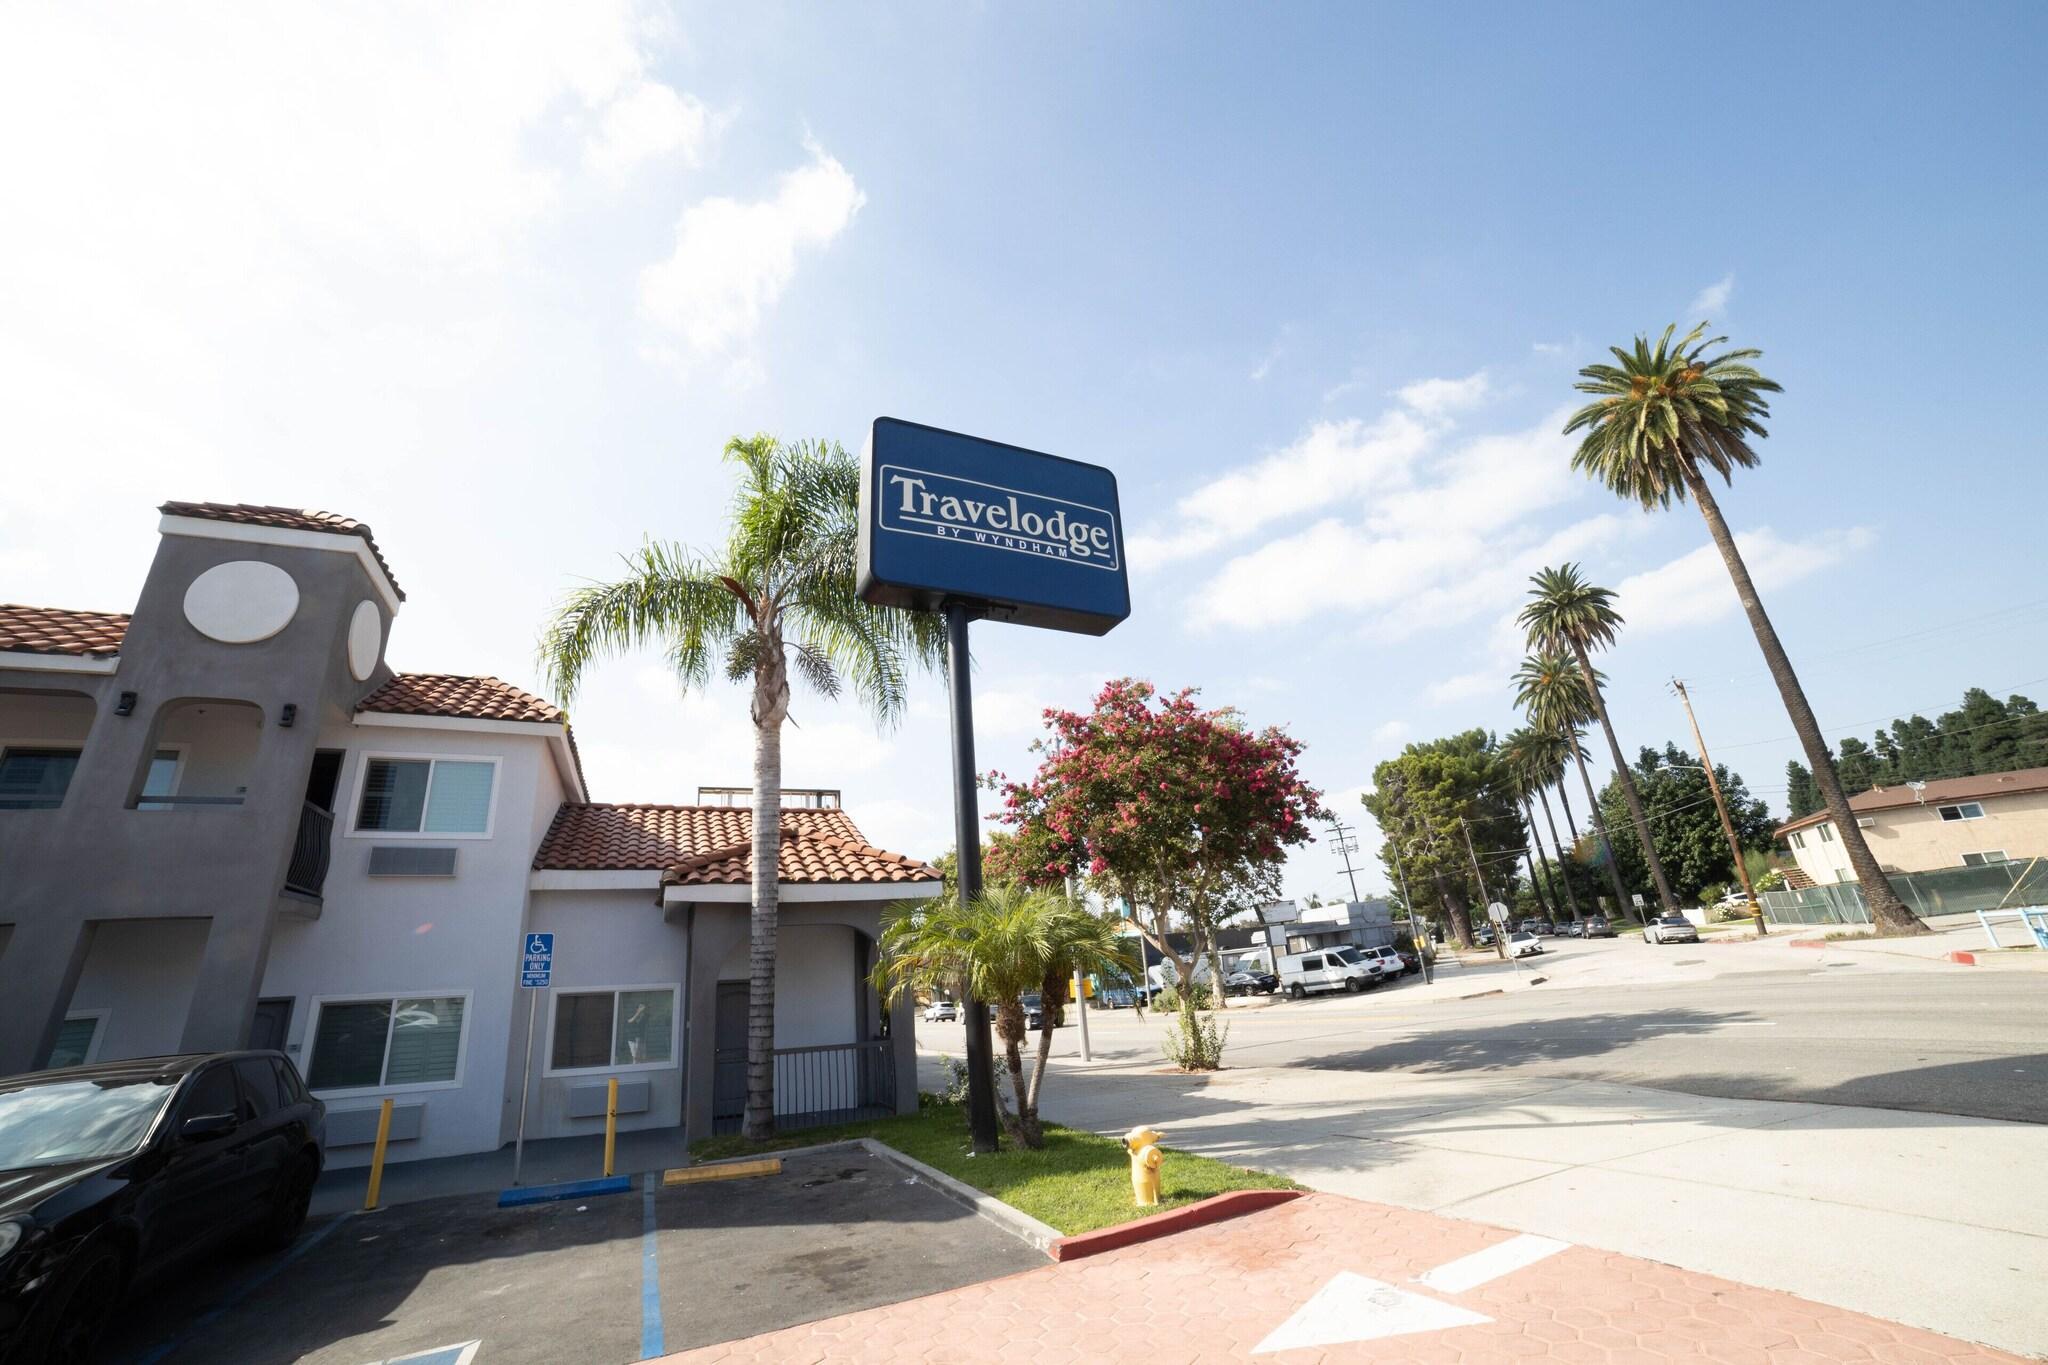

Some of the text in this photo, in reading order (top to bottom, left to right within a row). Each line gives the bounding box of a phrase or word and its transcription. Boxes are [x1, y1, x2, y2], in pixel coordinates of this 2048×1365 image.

[890, 474, 1109, 557] Travelodge
[937, 526, 1069, 558] BY WYNDHAM
[525, 953, 551, 962] PARKING
[529, 962, 545, 970] ONLY
